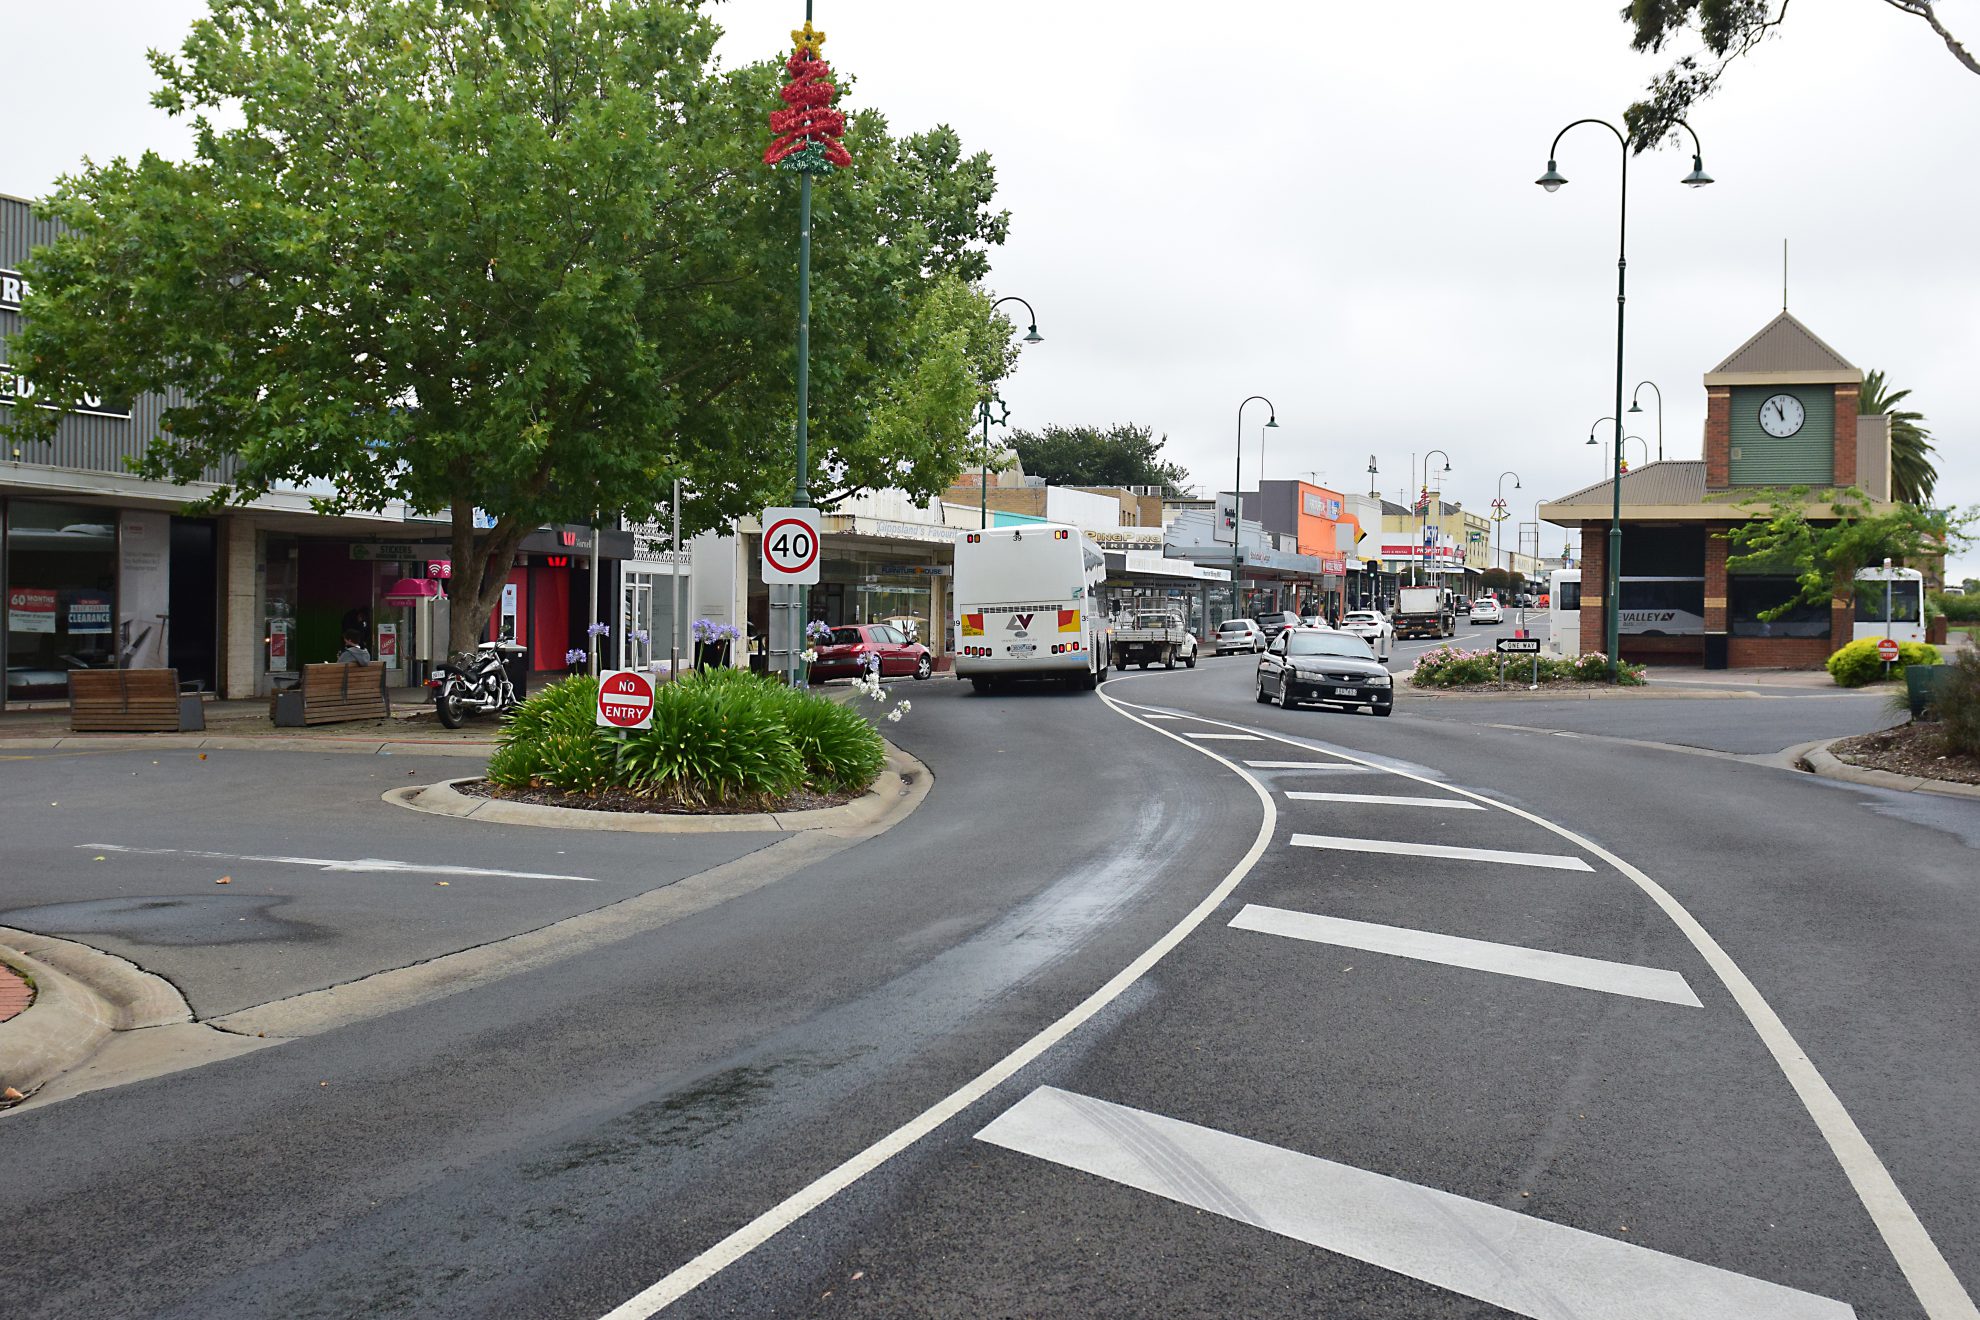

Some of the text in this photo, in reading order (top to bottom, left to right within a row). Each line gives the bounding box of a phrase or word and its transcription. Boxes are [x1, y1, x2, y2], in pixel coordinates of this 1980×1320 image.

[772, 534, 809, 558] 40
[11, 595, 26, 606] 60
[68, 613, 110, 622] CLEARANCE
[619, 681, 635, 692] NO
[605, 706, 644, 719] ENTRY
